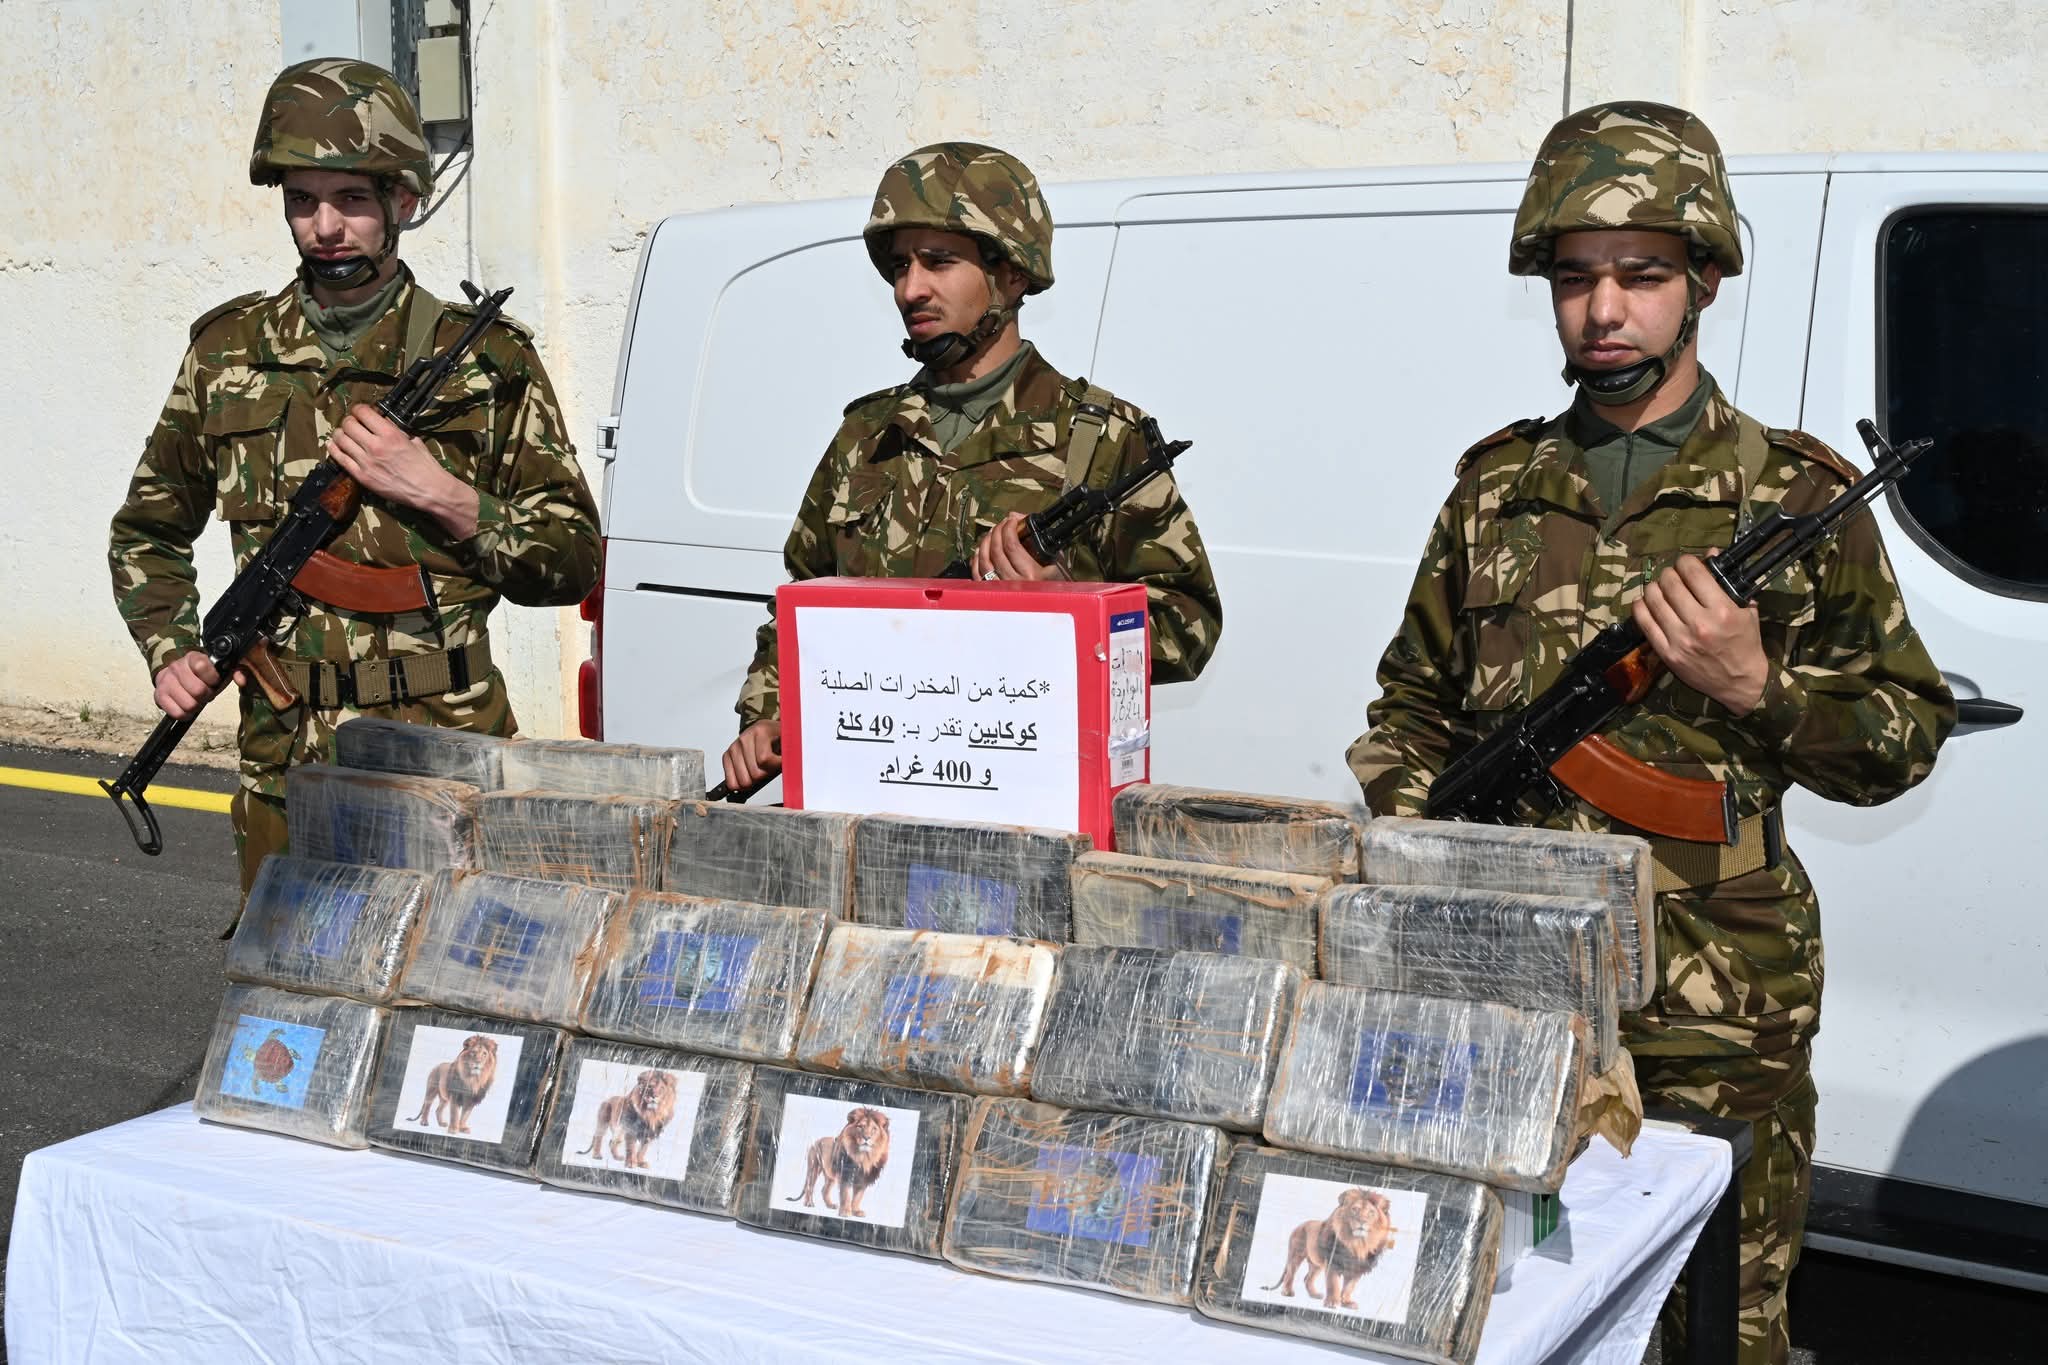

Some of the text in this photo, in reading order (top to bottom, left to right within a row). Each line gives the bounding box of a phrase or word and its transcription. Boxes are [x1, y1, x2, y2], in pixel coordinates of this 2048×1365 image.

[821, 670, 873, 693] الصلبة
[880, 674, 960, 701] المخدرات
[968, 683, 993, 703] من
[837, 711, 864, 741] كلغ
[869, 714, 894, 737] 49
[929, 717, 962, 743] تقدر
[968, 719, 1038, 747] كوكايين
[933, 759, 972, 783] 400
[980, 768, 992, 786] و
